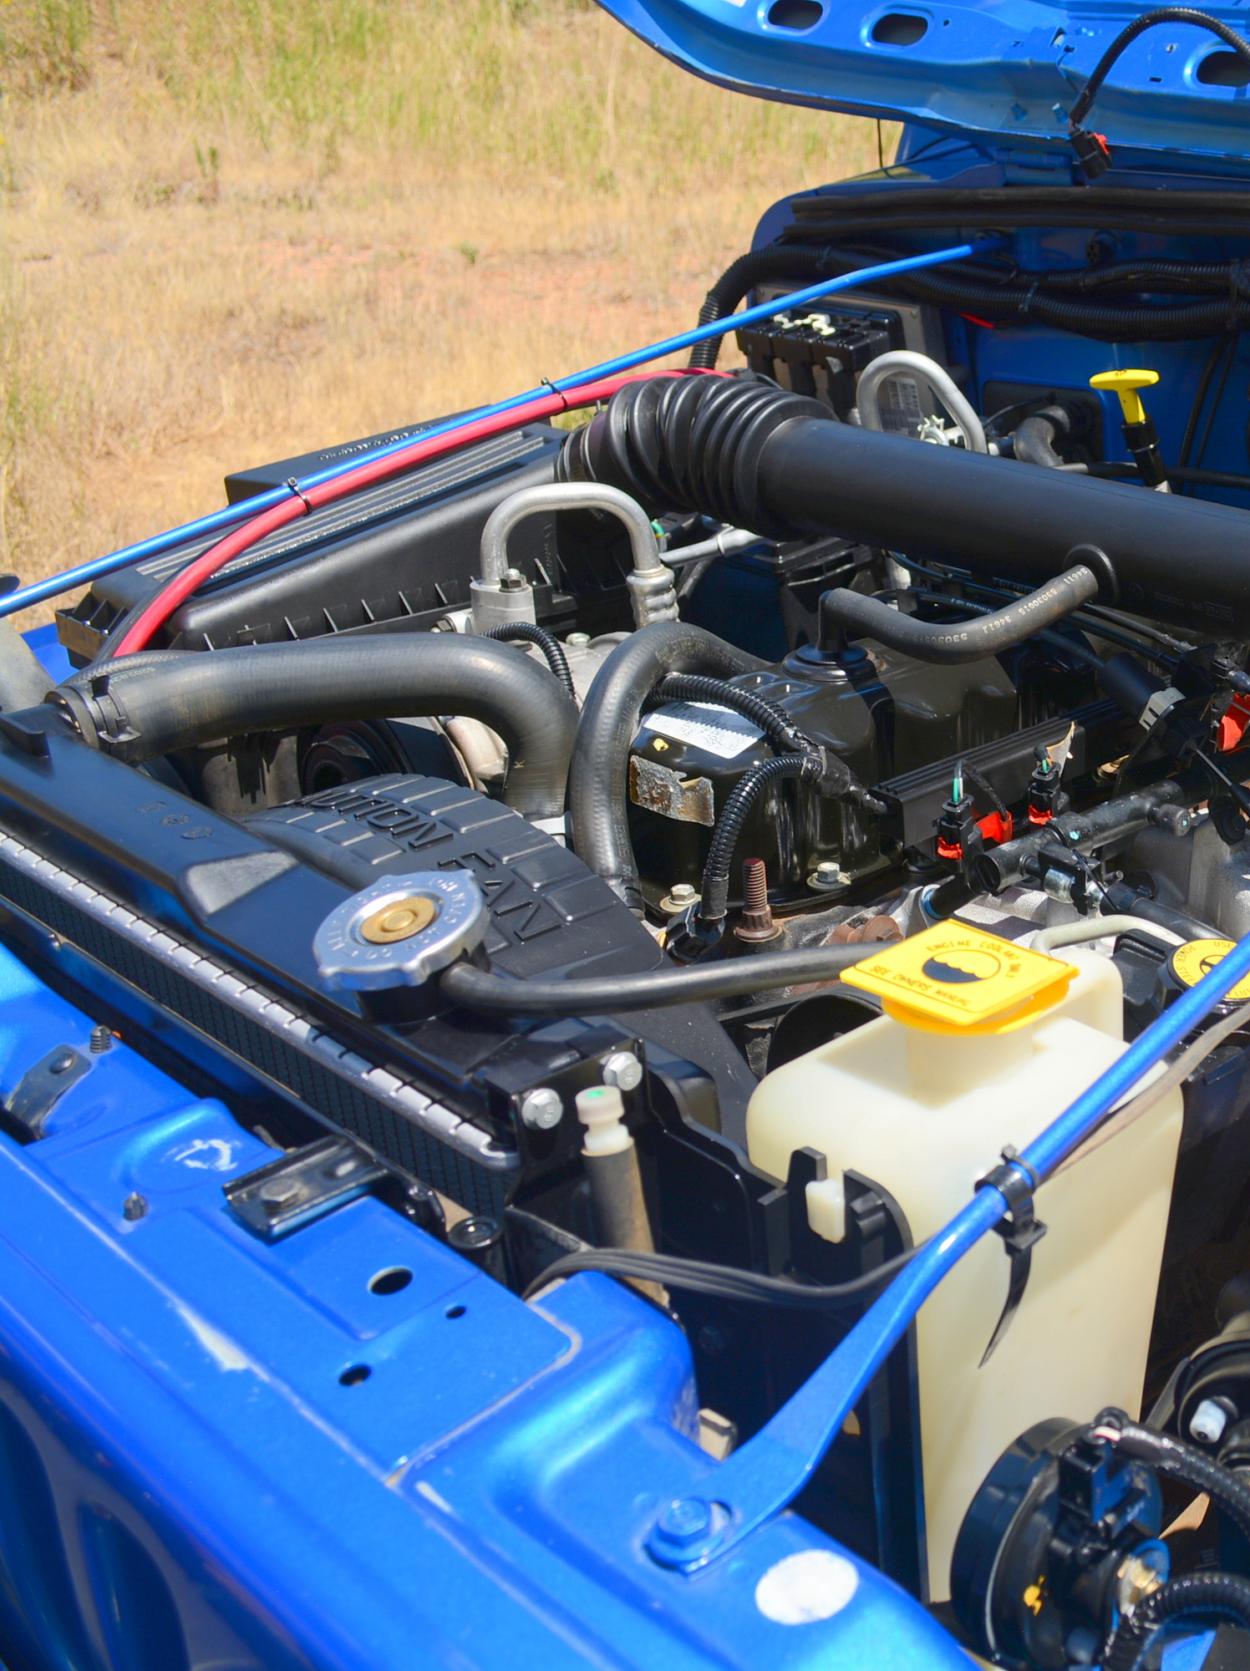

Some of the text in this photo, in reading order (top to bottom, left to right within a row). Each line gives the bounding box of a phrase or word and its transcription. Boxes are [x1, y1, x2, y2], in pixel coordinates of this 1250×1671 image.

[302, 790, 454, 850] UTION
[436, 851, 562, 942] FAN
[926, 940, 971, 952] ENGINE
